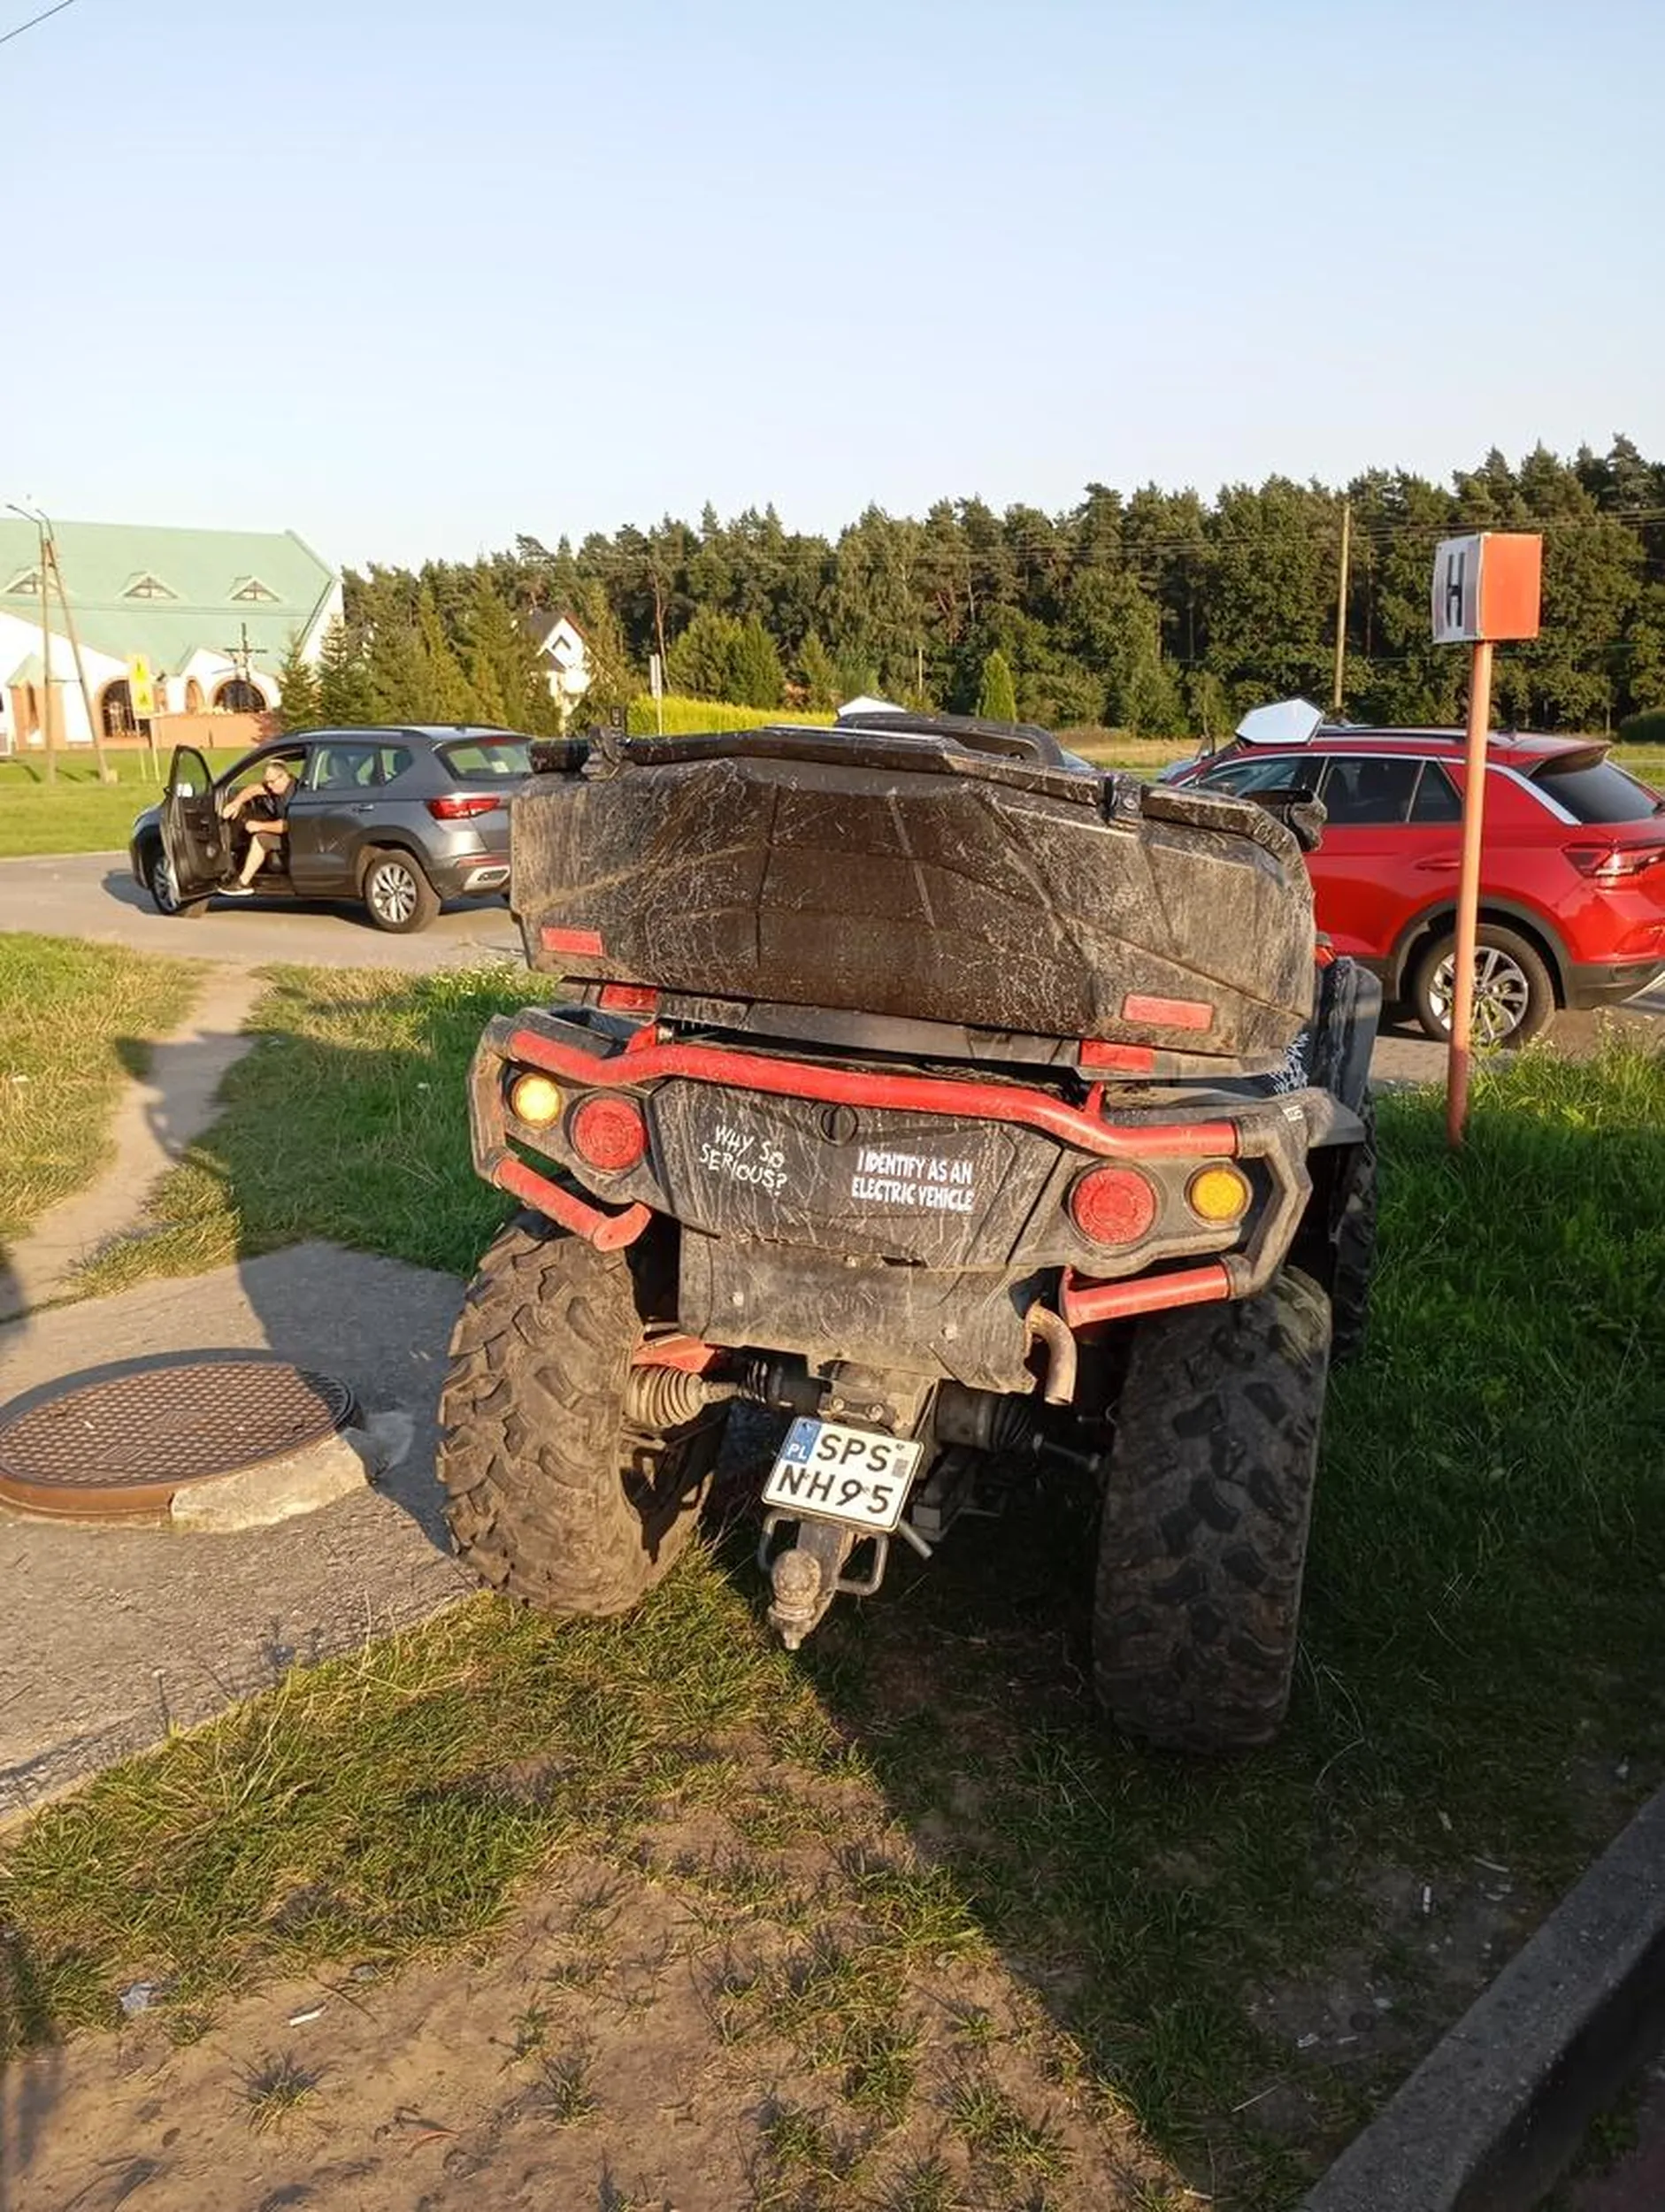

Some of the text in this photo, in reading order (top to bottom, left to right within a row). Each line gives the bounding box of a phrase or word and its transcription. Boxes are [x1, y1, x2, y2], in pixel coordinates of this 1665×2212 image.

[1446, 551, 1466, 627] H
[715, 1124, 785, 1168] WHY SO
[856, 1148, 973, 1185] I IDENTIFY AS AN
[699, 1143, 787, 1196] SERIOUS?
[852, 1176, 975, 1211] ELECTRIC VEHICLE
[786, 1443, 808, 1460] PL
[816, 1433, 892, 1471] SPS
[776, 1464, 894, 1514] NH95
